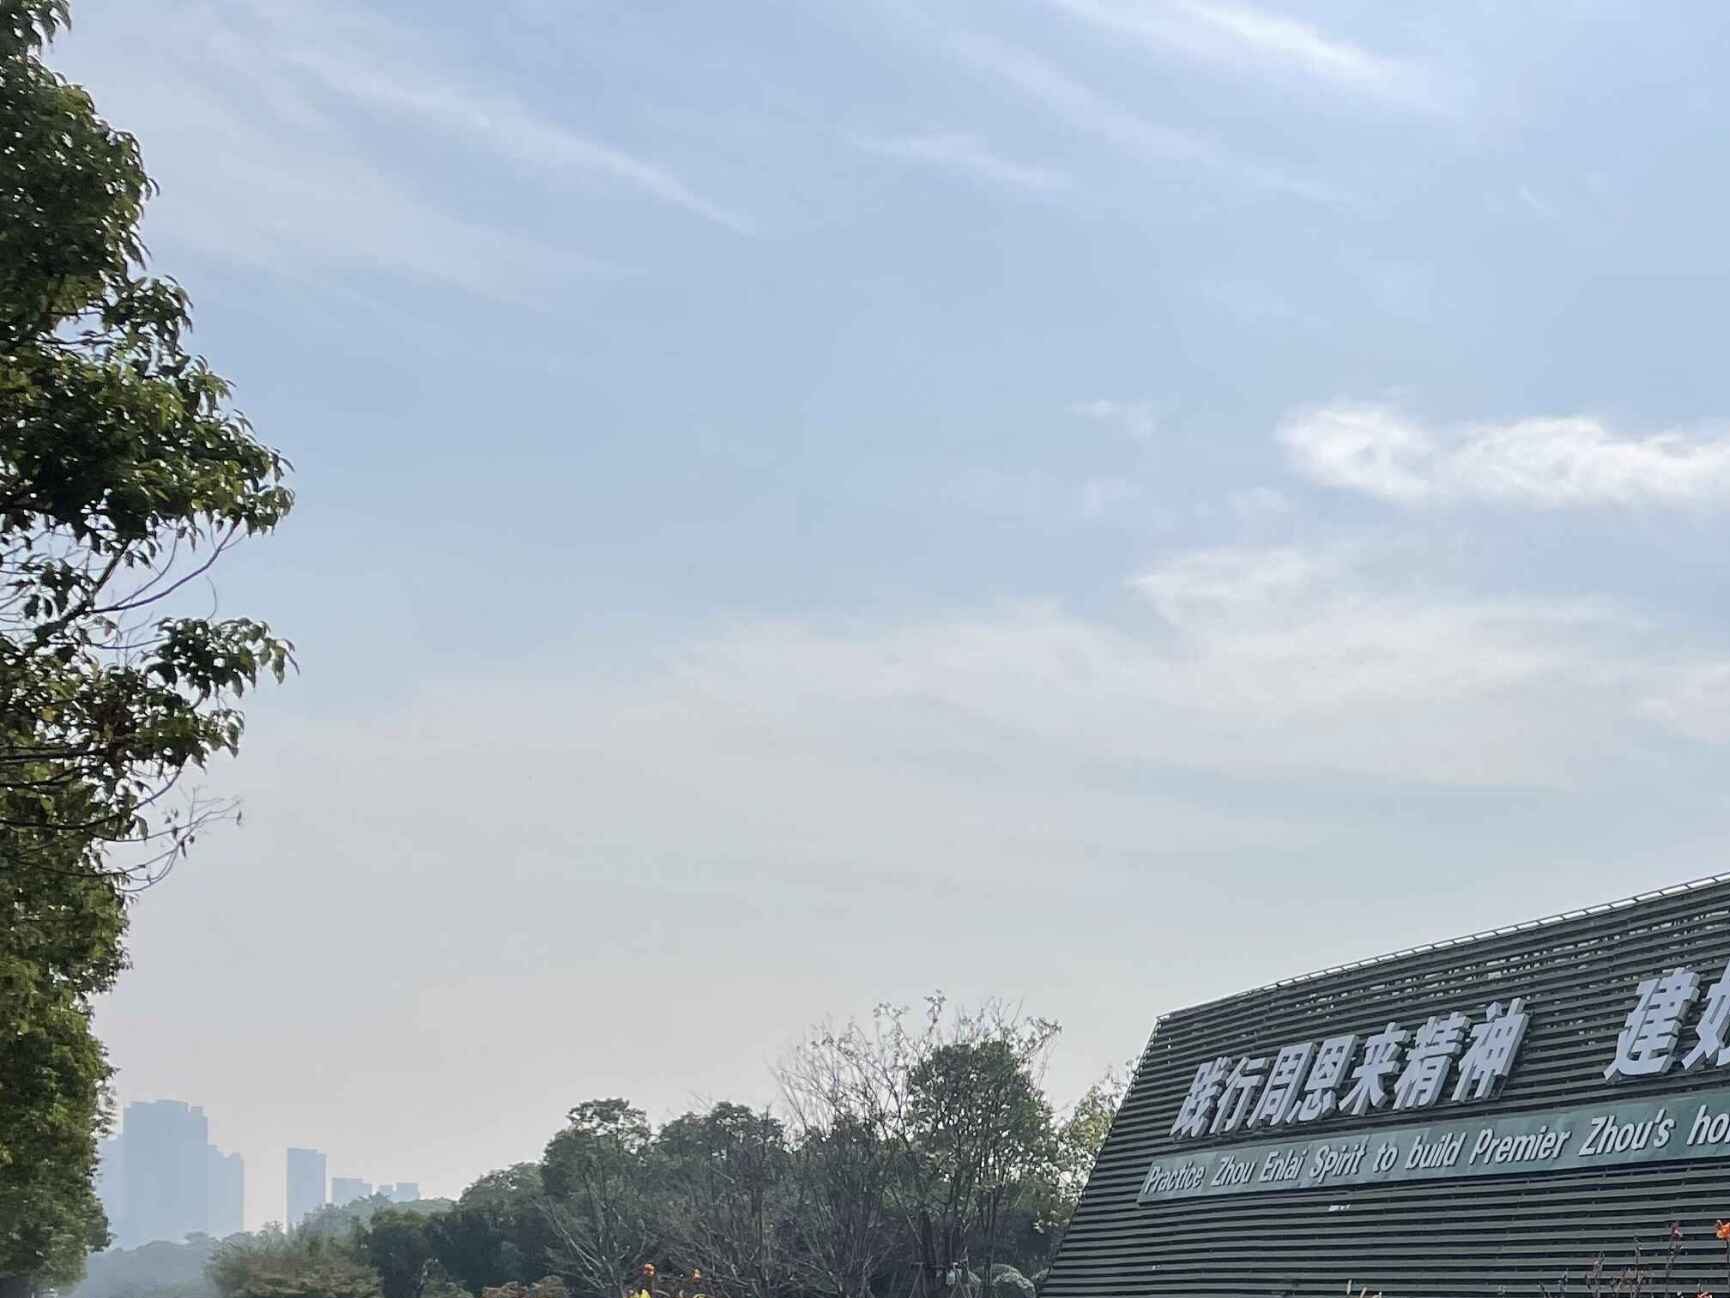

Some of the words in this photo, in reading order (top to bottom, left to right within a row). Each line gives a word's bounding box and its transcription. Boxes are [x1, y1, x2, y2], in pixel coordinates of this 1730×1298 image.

[1169, 997, 1529, 1139] 践行周恩来精神
[1145, 1164, 1205, 1193] Practice
[1211, 1155, 1255, 1185] Zhou
[1259, 1151, 1303, 1181] Enlai
[1310, 1142, 1365, 1182] Spirit
[1373, 1142, 1398, 1170] to
[1406, 1131, 1466, 1169] build
[1469, 1125, 1572, 1163] Premier
[1580, 1108, 1674, 1155] Zhou's
